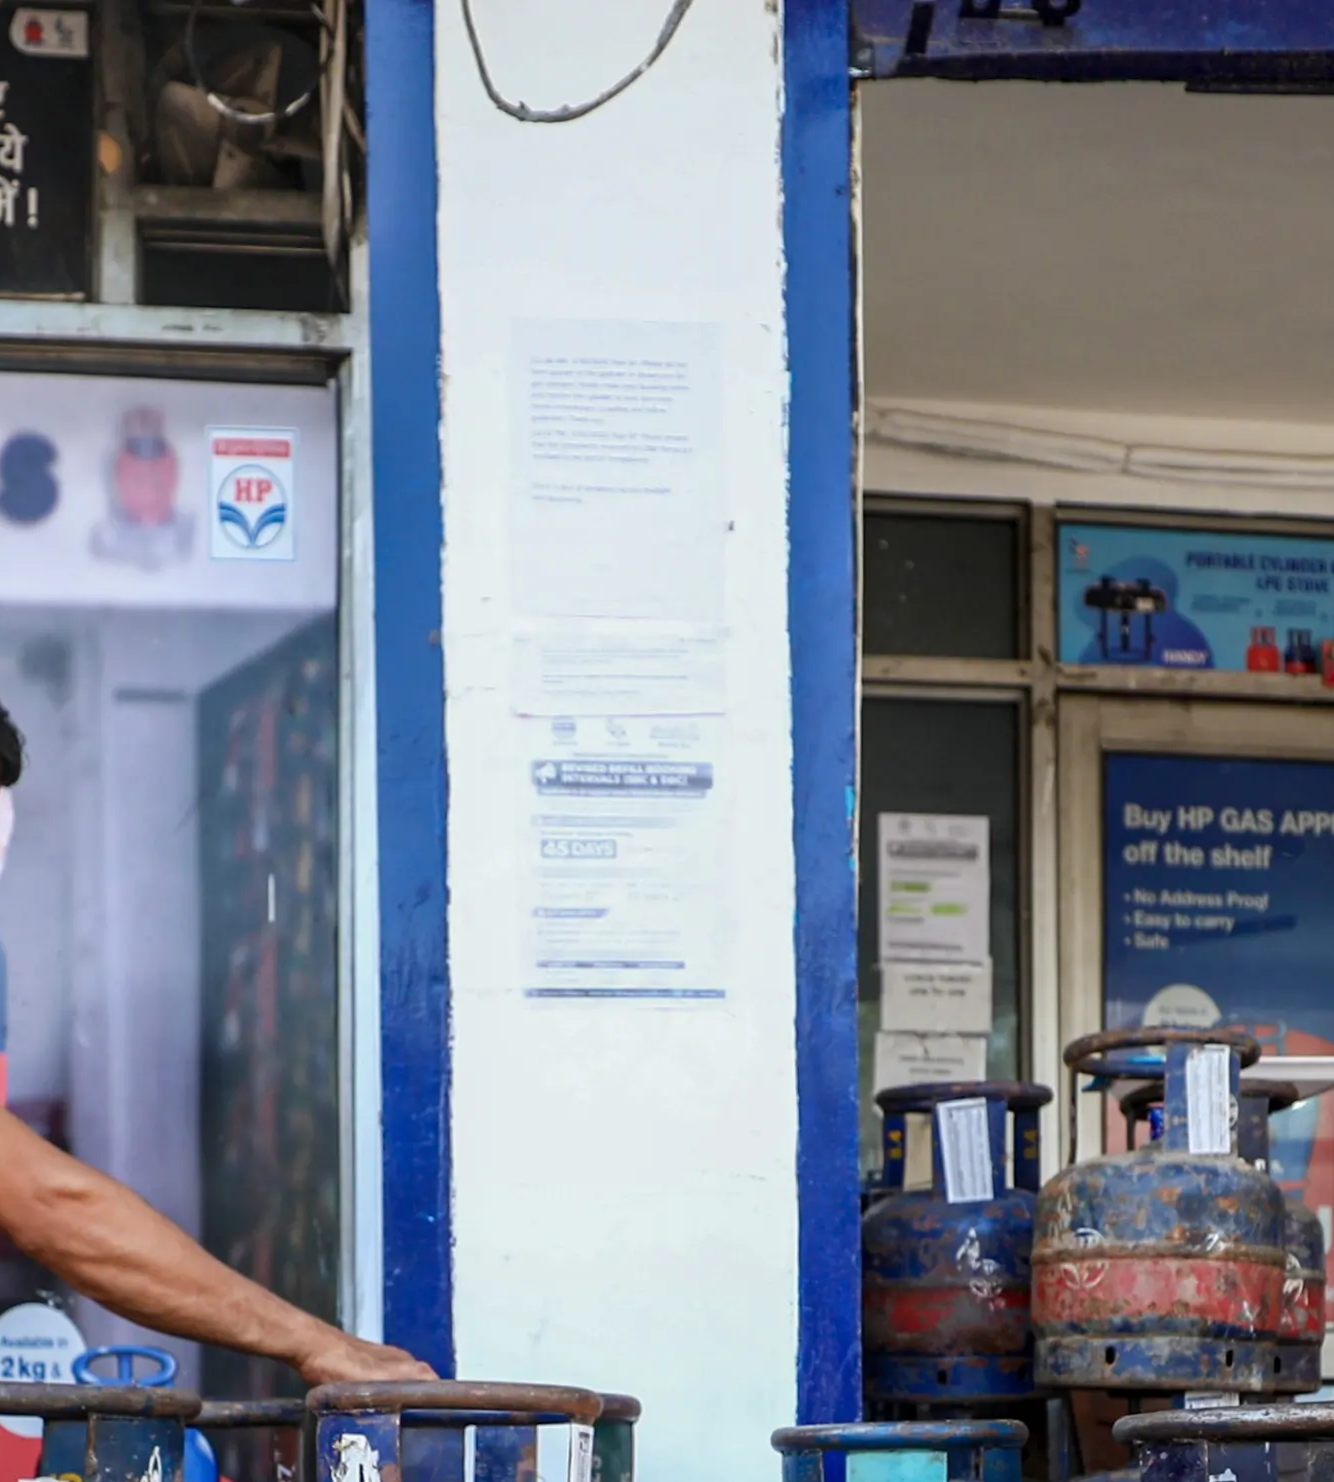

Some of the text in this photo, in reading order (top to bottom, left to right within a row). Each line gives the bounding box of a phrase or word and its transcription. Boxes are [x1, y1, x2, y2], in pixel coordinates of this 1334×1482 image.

[234, 477, 273, 503] HP
[1123, 803, 1171, 834] Buy
[1177, 805, 1214, 831] HP
[1220, 807, 1274, 834] GAS
[1123, 840, 1273, 870] off the shelf
[1133, 888, 1157, 906] No
